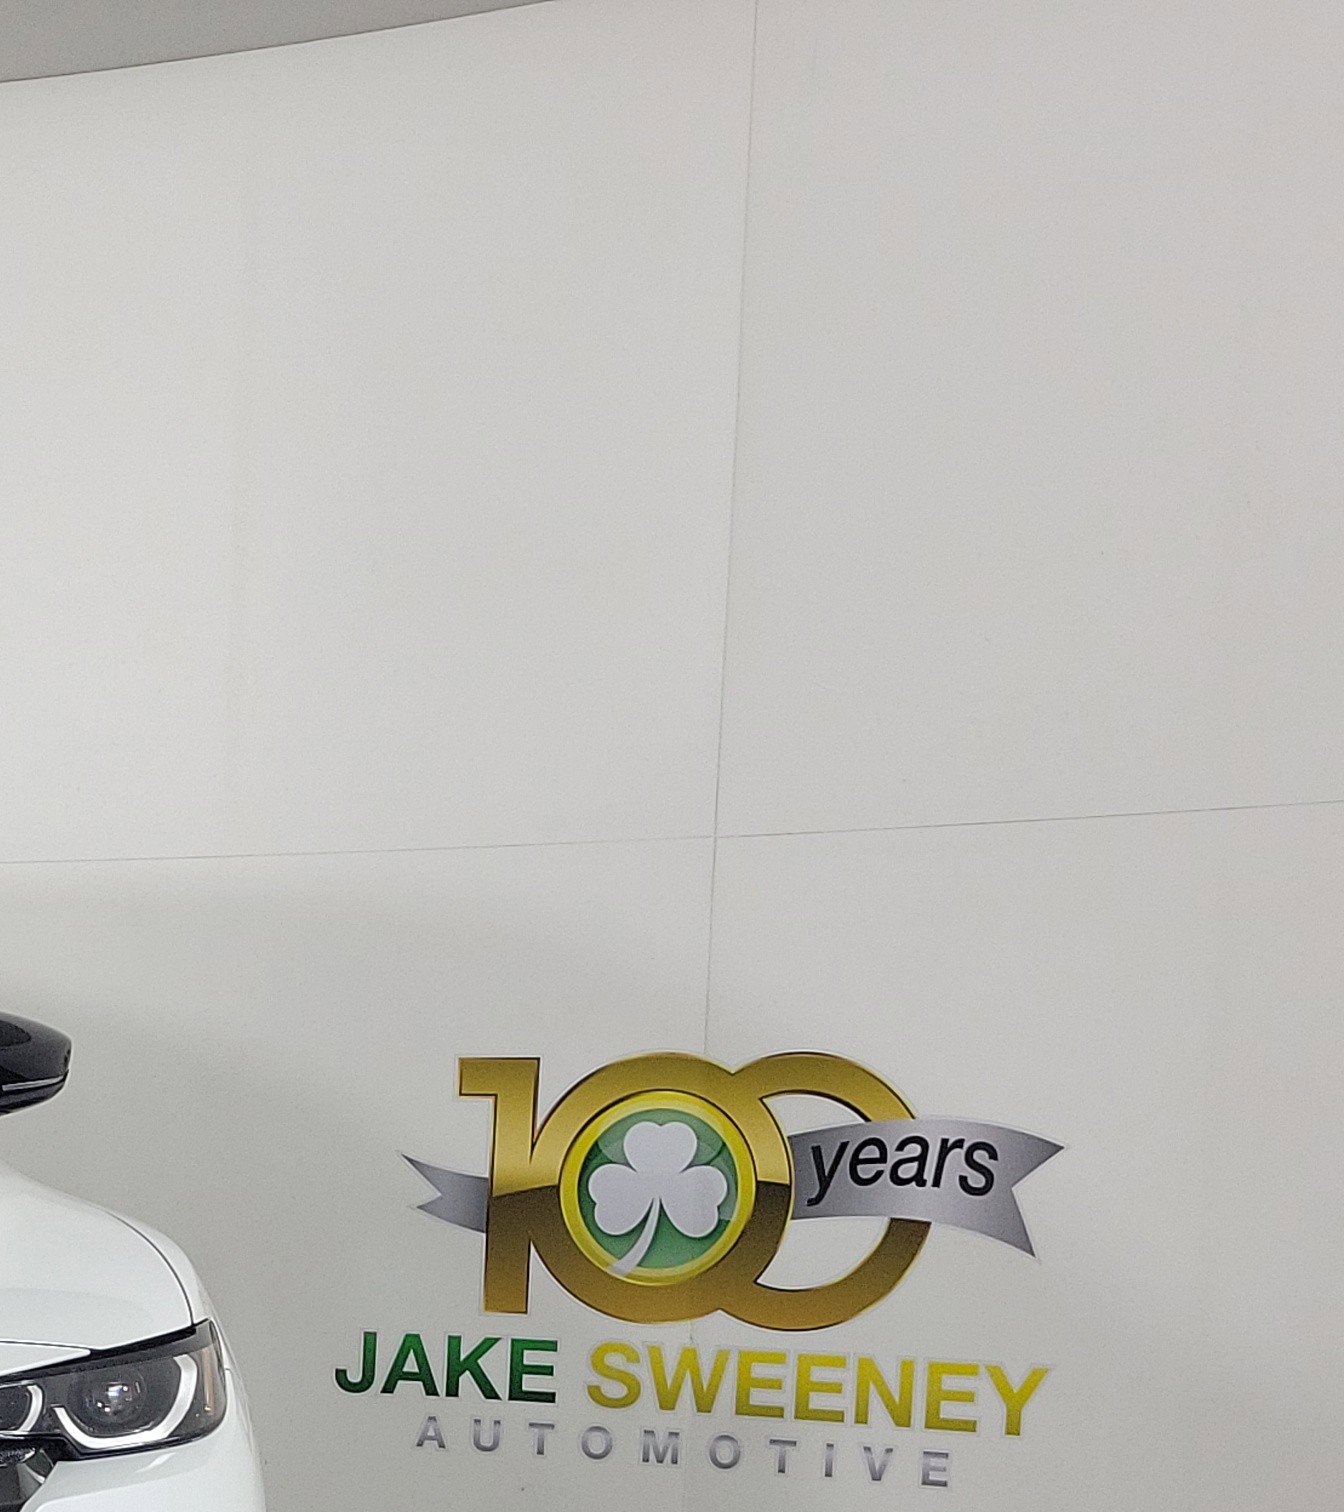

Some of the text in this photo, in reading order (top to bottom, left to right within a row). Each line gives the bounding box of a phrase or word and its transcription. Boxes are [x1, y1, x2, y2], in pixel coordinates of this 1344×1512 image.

[458, 1051, 999, 1333] 100 years
[334, 1331, 1049, 1436] JAKE SWEENEY
[415, 1415, 949, 1488] AUTOMOTIVE
